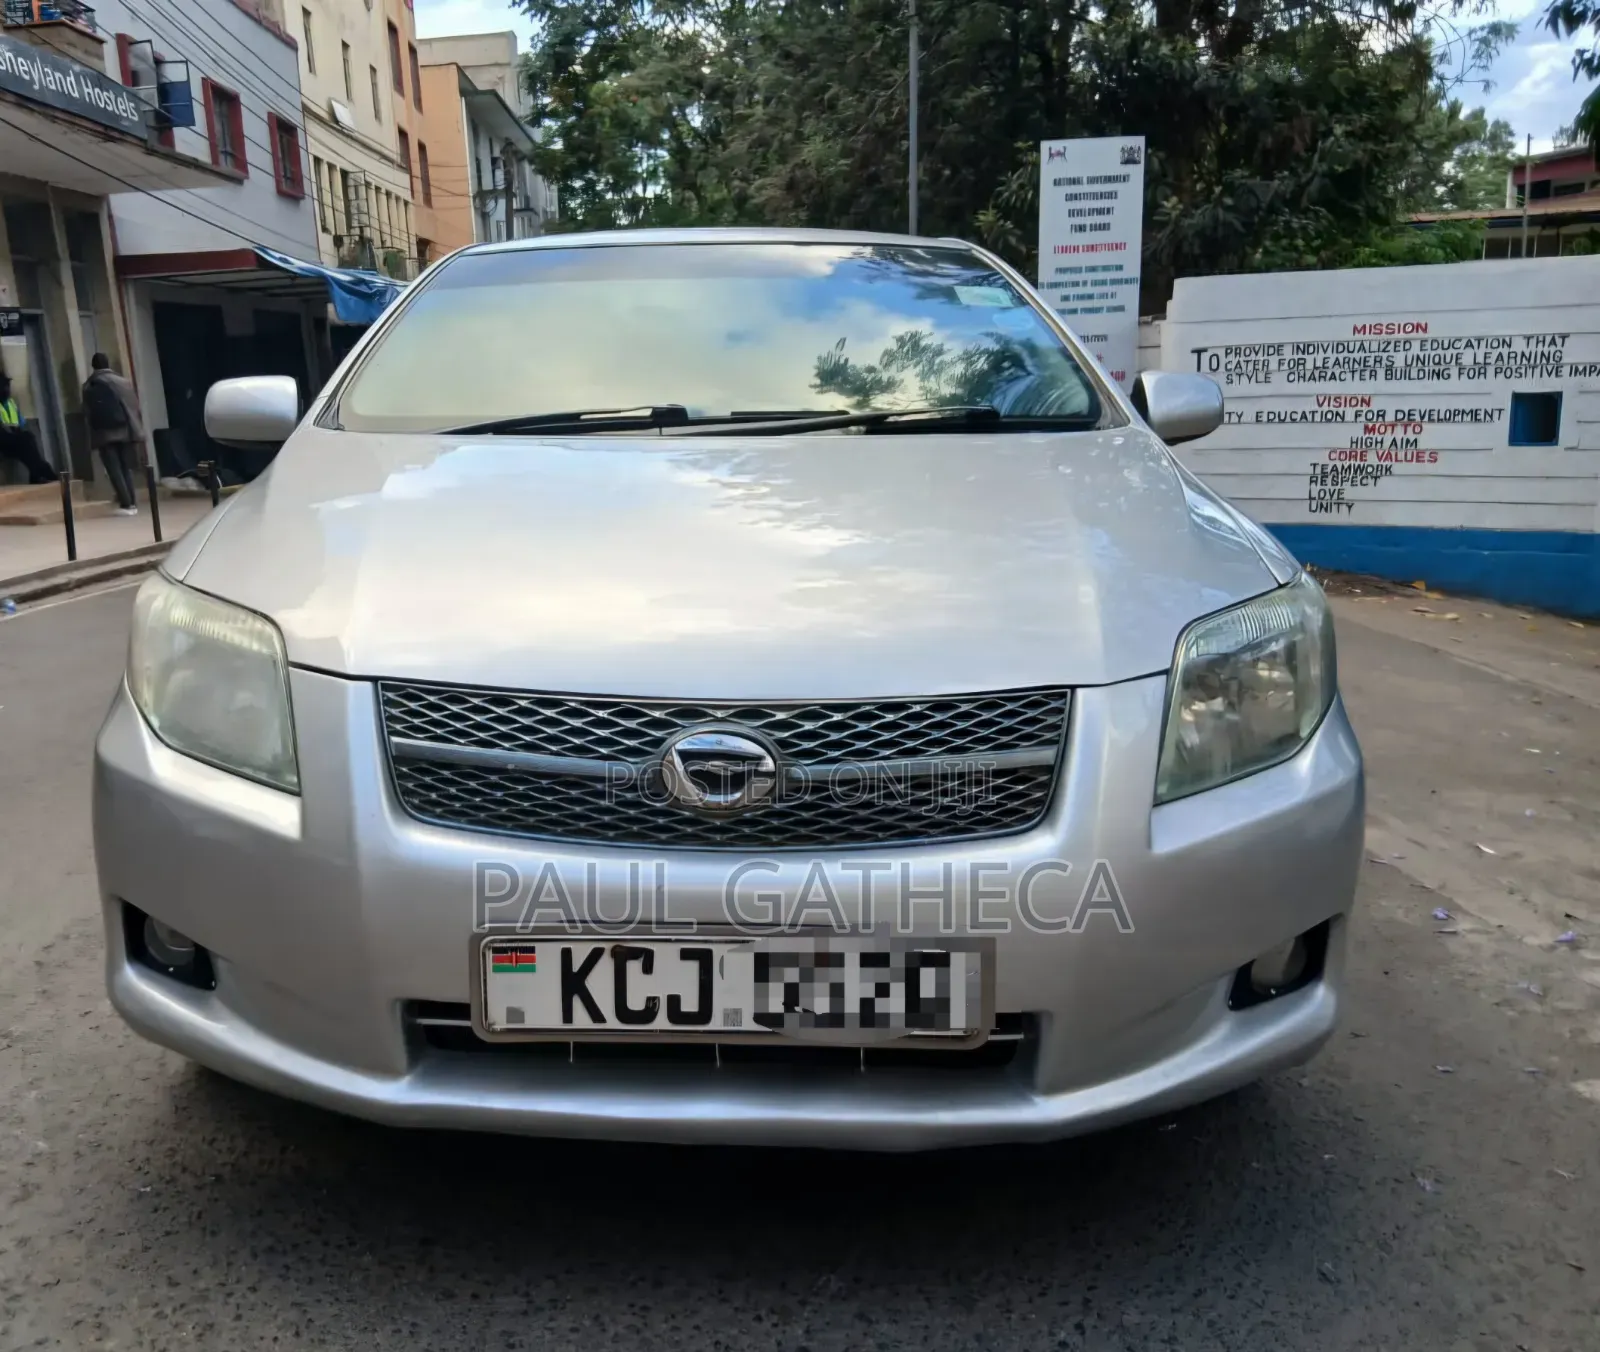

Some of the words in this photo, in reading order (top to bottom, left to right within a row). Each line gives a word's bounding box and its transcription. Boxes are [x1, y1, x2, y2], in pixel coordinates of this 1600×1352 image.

[80, 75, 139, 121] Hostels
[1353, 322, 1428, 336] MISSION
[1225, 344, 1285, 359] PROVIDE
[1292, 340, 1413, 356] INDIVIDUALIZED
[1420, 336, 1512, 352] EDUCATION
[1523, 334, 1571, 349] THAT
[1225, 358, 1270, 373] CATER
[1278, 358, 1307, 373] FOR
[1313, 354, 1395, 370] LEARNERS
[1404, 352, 1464, 368] UNIQUE
[1473, 349, 1563, 366] LEARNING
[1226, 372, 1272, 386] STYLE
[1286, 369, 1377, 384] CHARACTER
[1384, 366, 1451, 381] BUILDING
[1457, 366, 1488, 381] FOR
[1494, 364, 1564, 380] POSITIVE
[1315, 395, 1371, 408] VISION
[1255, 410, 1346, 424] EDUCATION
[1354, 409, 1386, 423] FOR
[1394, 408, 1505, 423] DEVELOPMENT
[1350, 436, 1384, 450] HIGH
[1388, 436, 1418, 450] AIM
[1328, 450, 1368, 463] CORE
[1375, 450, 1439, 464] VALUES
[1310, 463, 1393, 476] TEAMWORK
[1309, 475, 1381, 488] RESPECT
[1308, 488, 1346, 501] LOVE
[1308, 501, 1355, 515] UNITY
[560, 946, 714, 1026] KCJ
